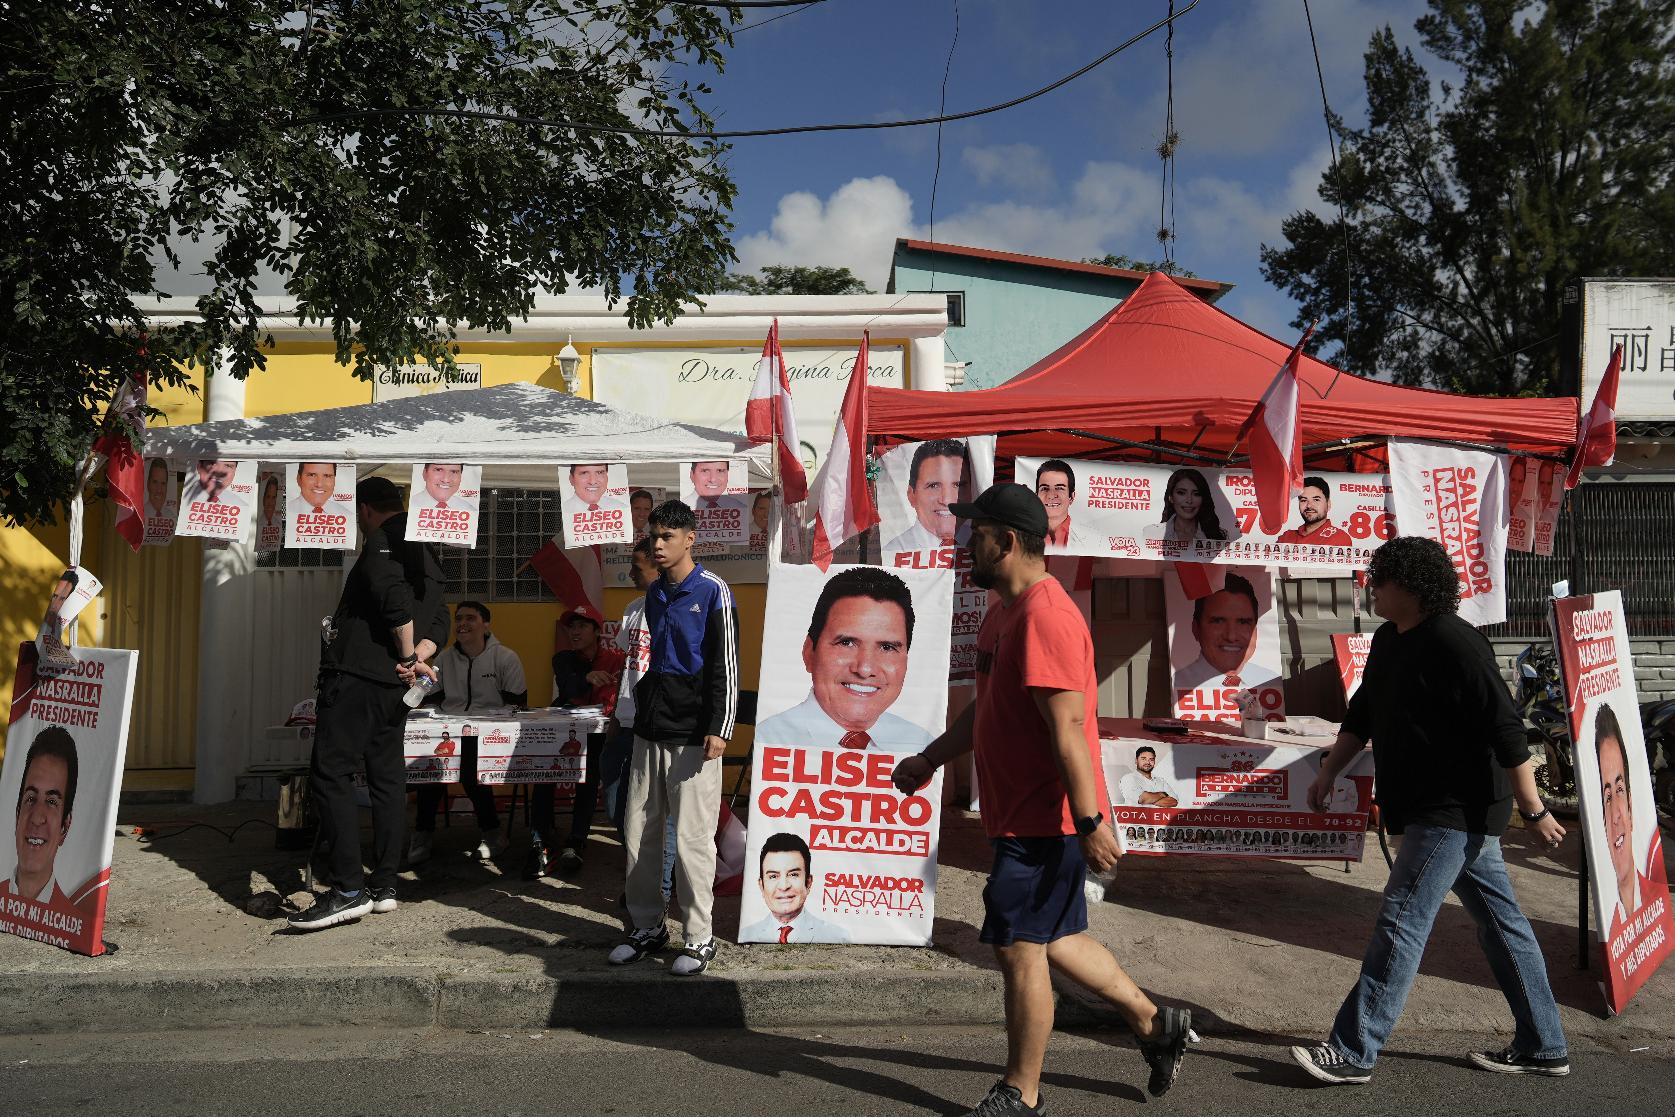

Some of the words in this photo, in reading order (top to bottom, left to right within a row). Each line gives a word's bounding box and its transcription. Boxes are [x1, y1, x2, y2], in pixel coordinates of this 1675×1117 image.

[678, 357, 743, 383] Dra.
[1089, 476, 1150, 488] SALVADOR
[1340, 484, 1393, 493] BERNARD
[1089, 488, 1150, 500] NASRALLA
[190, 502, 240, 516] ELISEO
[419, 508, 470, 521] ELISEO
[1088, 500, 1150, 511] PRESIDENTE
[1421, 470, 1437, 543] PRESI
[189, 513, 238, 525] CASTRO
[297, 514, 346, 525] ELISEO
[417, 520, 469, 530] CASTRO
[573, 510, 622, 523] ELISEO
[574, 521, 623, 532] CASTRO
[1341, 512, 1397, 540] #86
[187, 525, 237, 535] ALCALDE
[296, 525, 346, 535] CASTRO
[416, 531, 468, 540] ALCALDE
[575, 532, 625, 542] ALCALDE
[1457, 466, 1493, 595] SALVADOR
[894, 547, 976, 569] ELISE
[1574, 611, 1613, 637] SALVADOR
[1578, 639, 1617, 668] NASRALLA
[37, 680, 99, 705] NASRALLA
[1581, 668, 1621, 699] PRESIDENTE
[1177, 688, 1283, 711] ELISO
[31, 703, 98, 729] PRESIDENTE
[762, 747, 932, 792] ELISE
[758, 787, 932, 827] CASTRO
[1153, 812, 1170, 821] EN
[1177, 813, 1241, 823] PLANCHA
[1247, 815, 1292, 825] DESDE
[1298, 817, 1313, 826] EL
[1324, 818, 1362, 827] 70-92
[813, 829, 926, 854] ALCALDE
[824, 873, 924, 893] SALVADOR
[823, 888, 924, 911] NASRALLA
[7, 898, 27, 919] POR
[28, 905, 40, 923] MI
[42, 910, 83, 936] ALCALDE
[823, 907, 924, 919] PRESIDENTE
[1623, 923, 1636, 948] POR
[1642, 897, 1664, 929] ALCALDE
[1620, 962, 1626, 981] Y
[1626, 951, 1638, 976] MIS
[1635, 924, 1665, 965] DIPUTADOS
